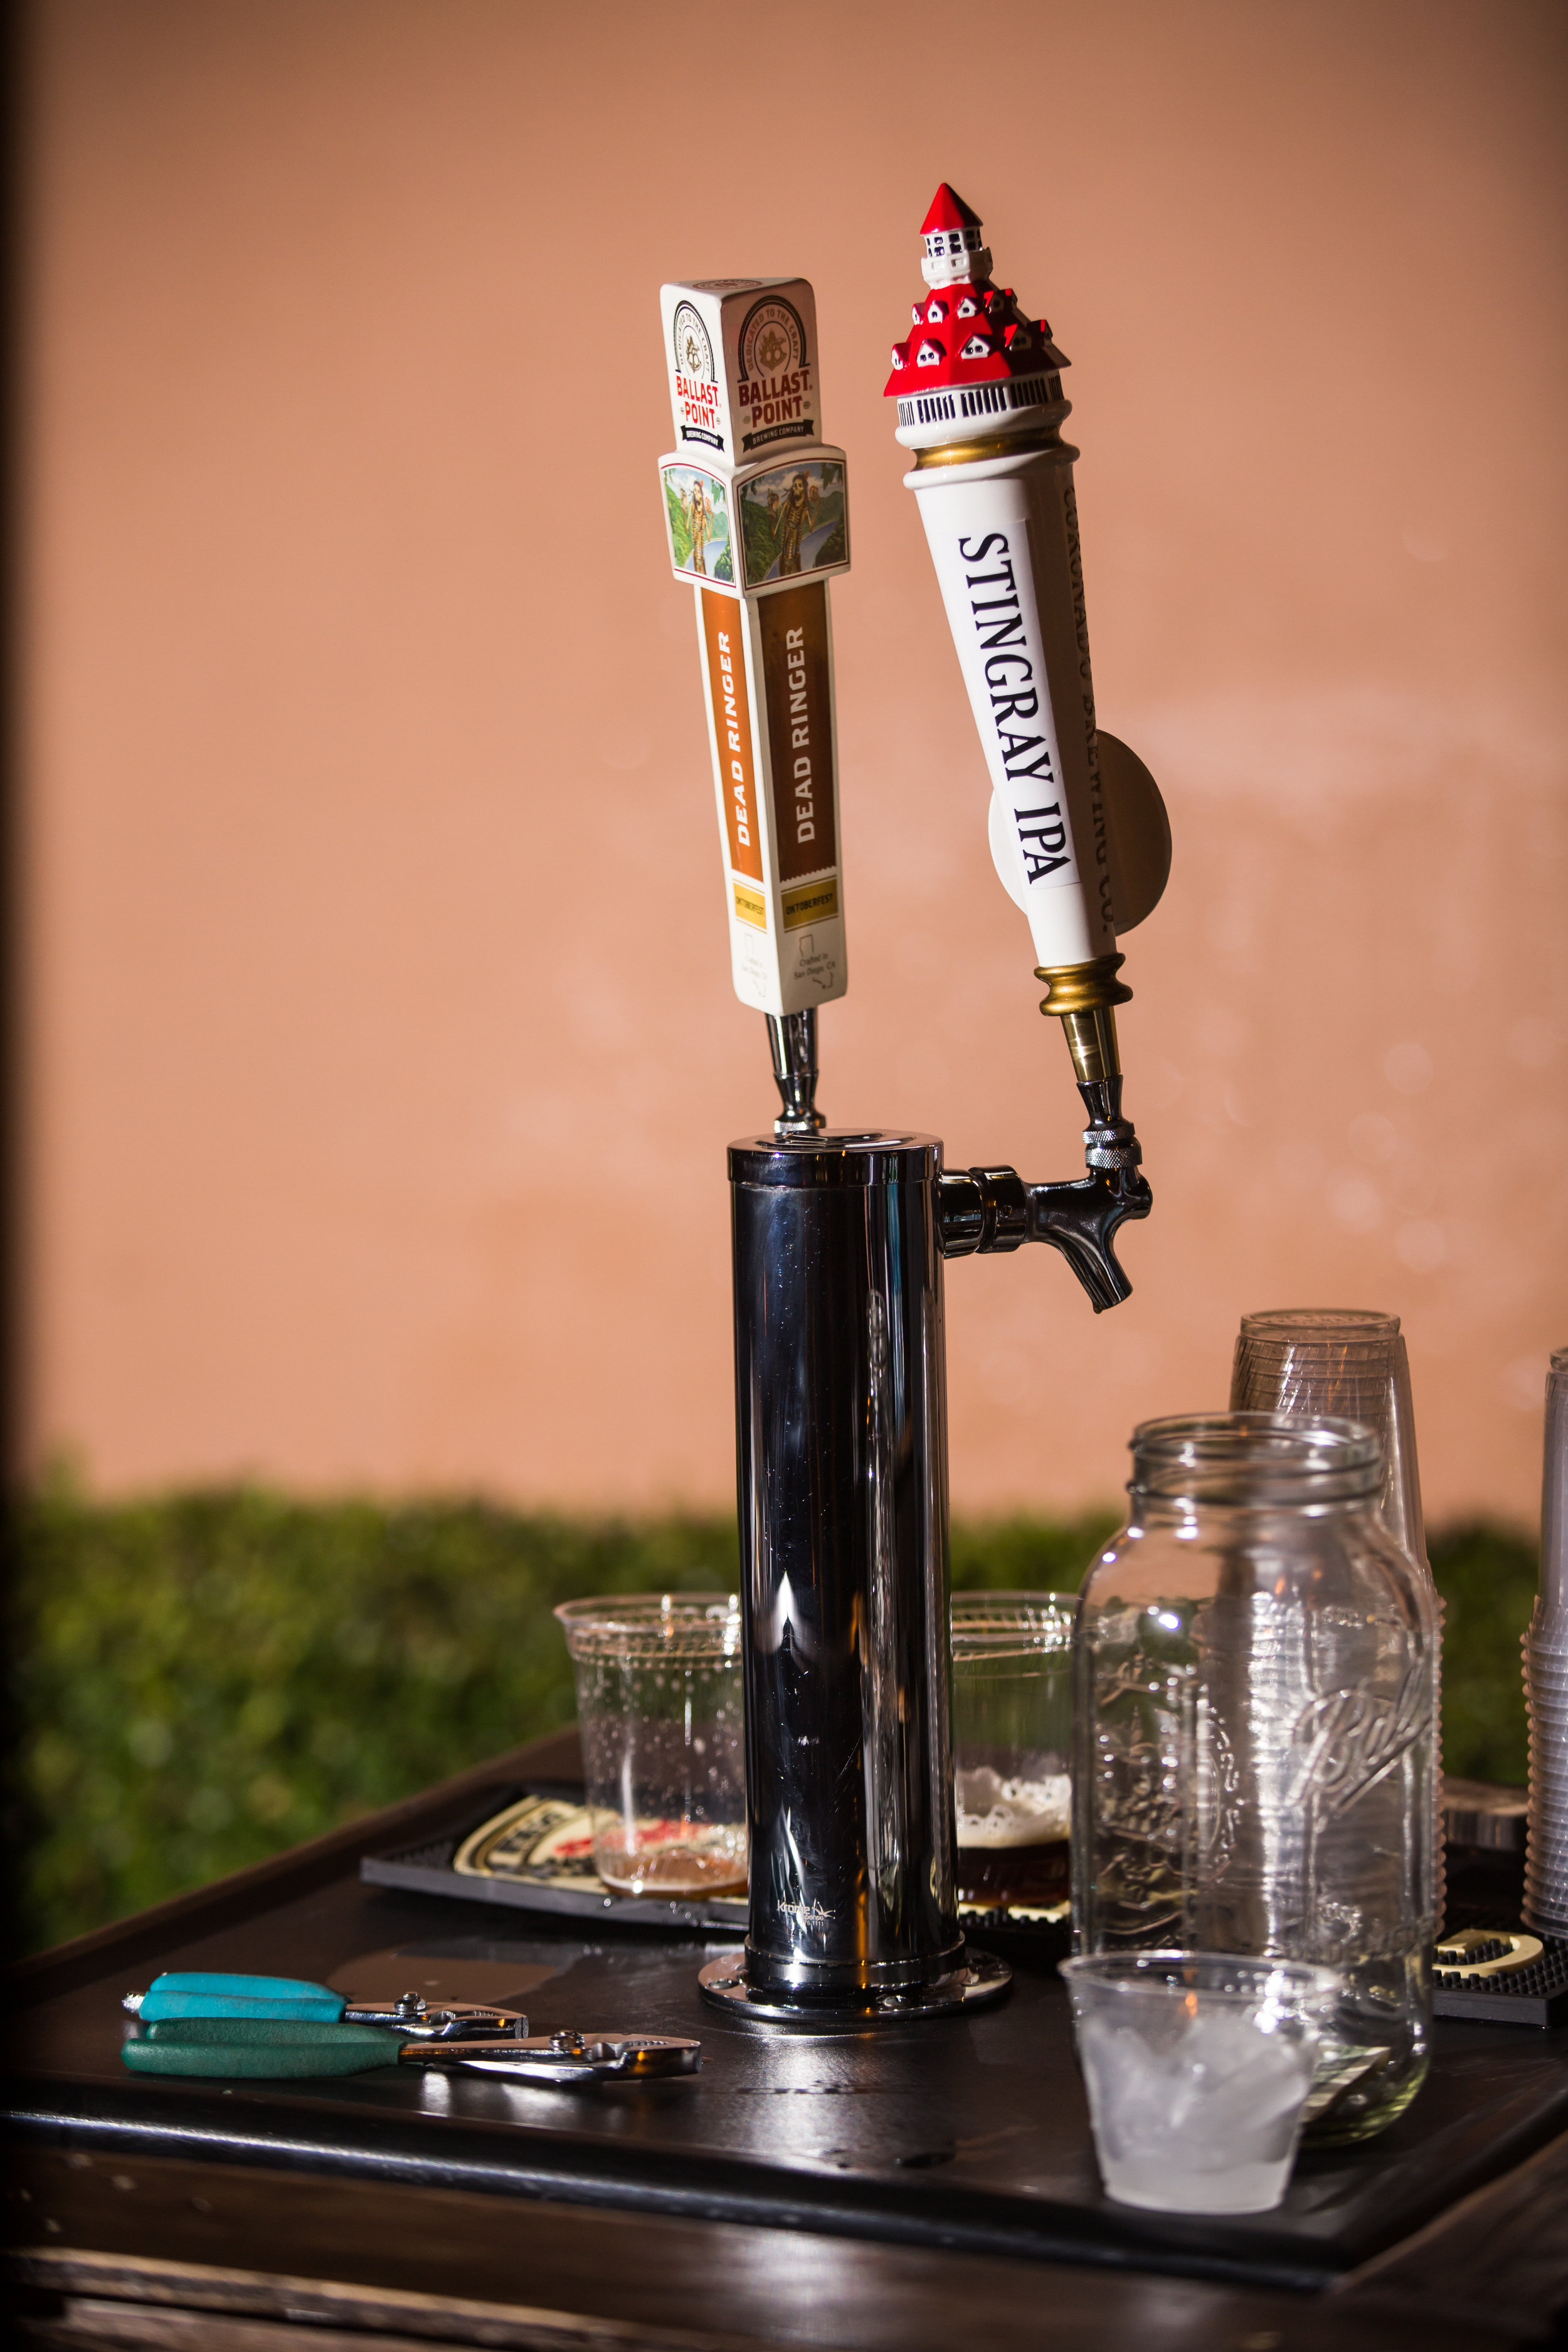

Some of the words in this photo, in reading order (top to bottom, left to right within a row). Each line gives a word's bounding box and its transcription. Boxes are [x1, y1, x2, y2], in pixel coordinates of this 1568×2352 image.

[746, 313, 765, 372] DEDICATED
[766, 308, 775, 319] TO
[777, 309, 790, 326] THE
[788, 325, 799, 361] CRAFT
[676, 375, 719, 407] BALLAST
[738, 369, 810, 407] BALLAST
[684, 401, 715, 429] POINT
[751, 395, 803, 428] POINT
[752, 430, 778, 445] BREWING
[778, 426, 804, 436] COMPANY
[718, 631, 741, 753] RINGER
[786, 627, 810, 750] RINGER
[958, 532, 1054, 783] STINGRAY
[1014, 801, 1072, 886] IPA
[731, 760, 751, 847] DEAD
[793, 756, 815, 844] DEAD
[785, 893, 834, 916] OKTOBERFEST
[793, 971, 806, 980] San
[826, 961, 835, 970] CA
[799, 953, 821, 967] Crafted
